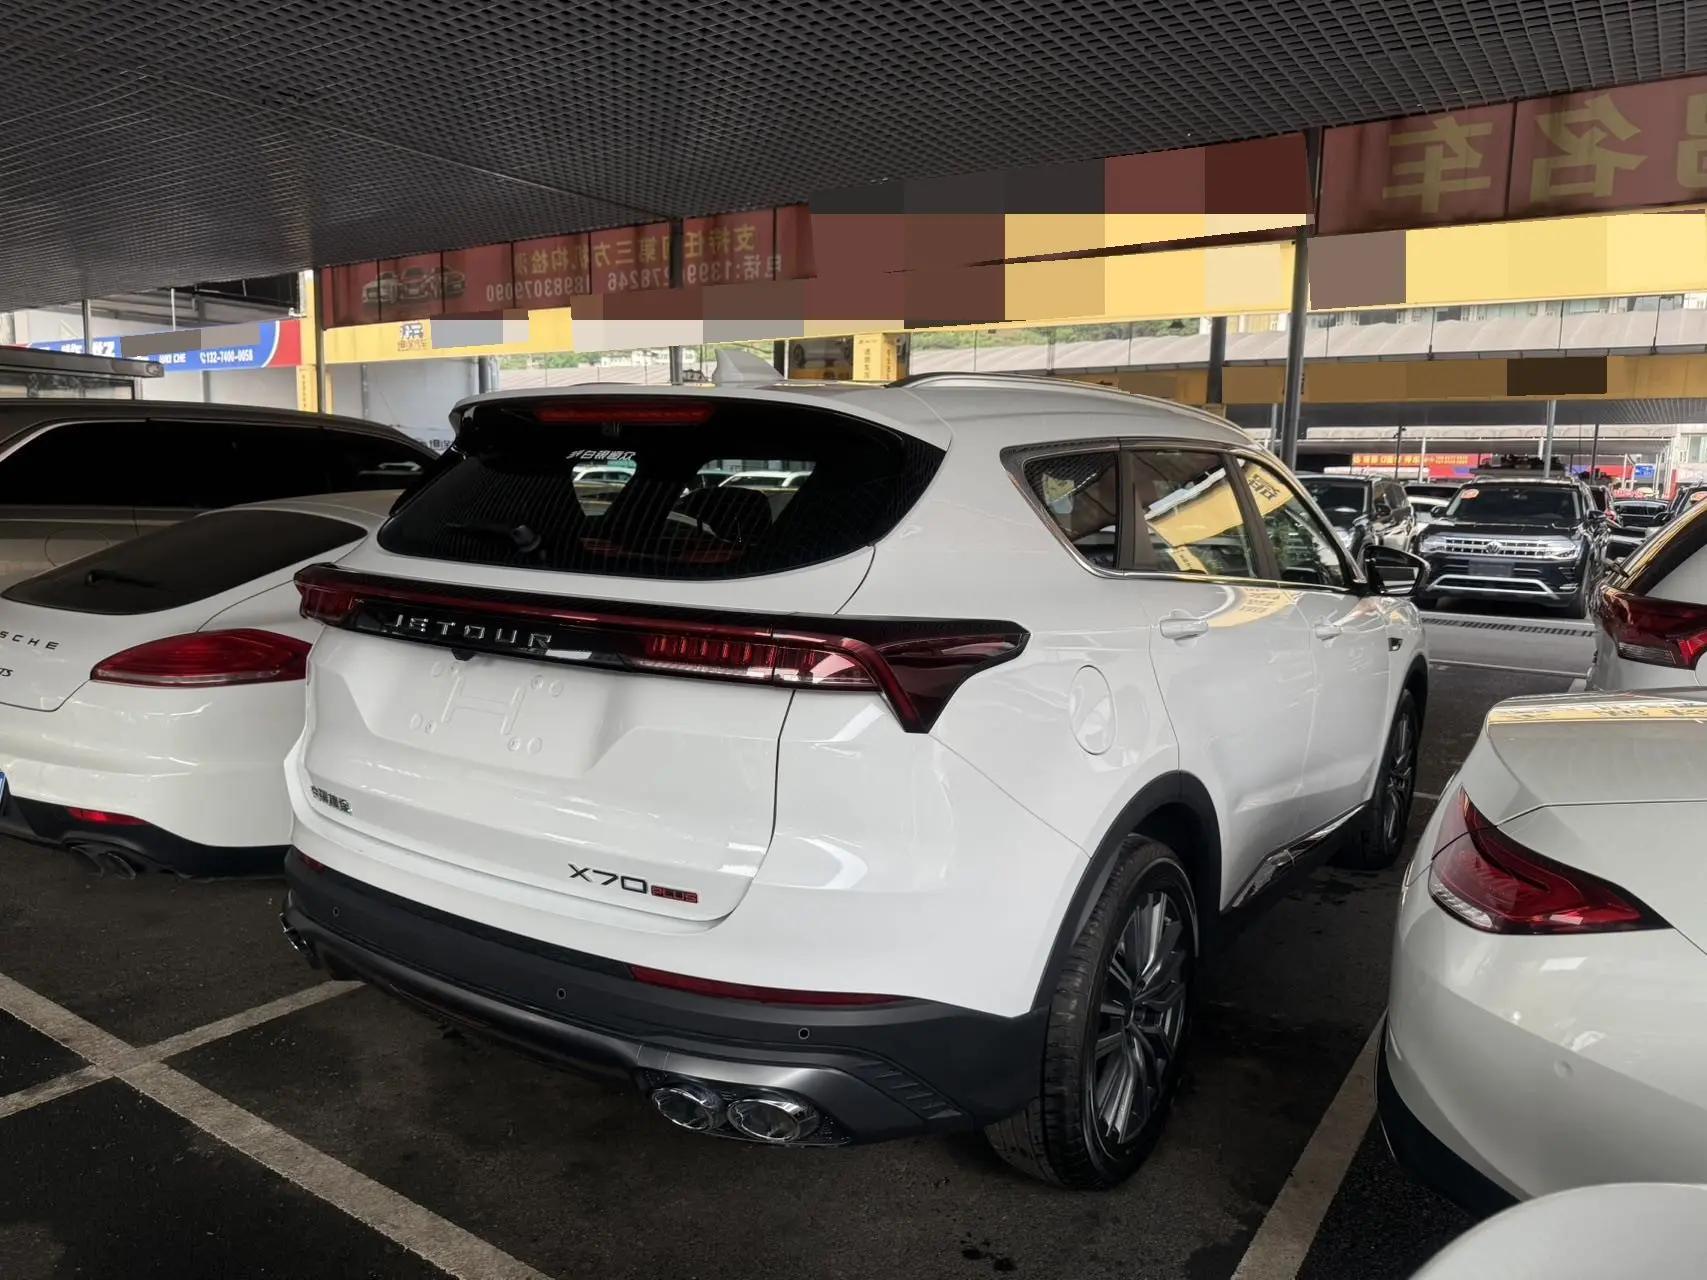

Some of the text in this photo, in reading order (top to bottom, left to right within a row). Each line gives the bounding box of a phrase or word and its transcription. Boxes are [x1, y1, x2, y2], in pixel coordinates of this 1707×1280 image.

[385, 613, 552, 650] JETOUR
[567, 862, 699, 904] X70 PLUS
